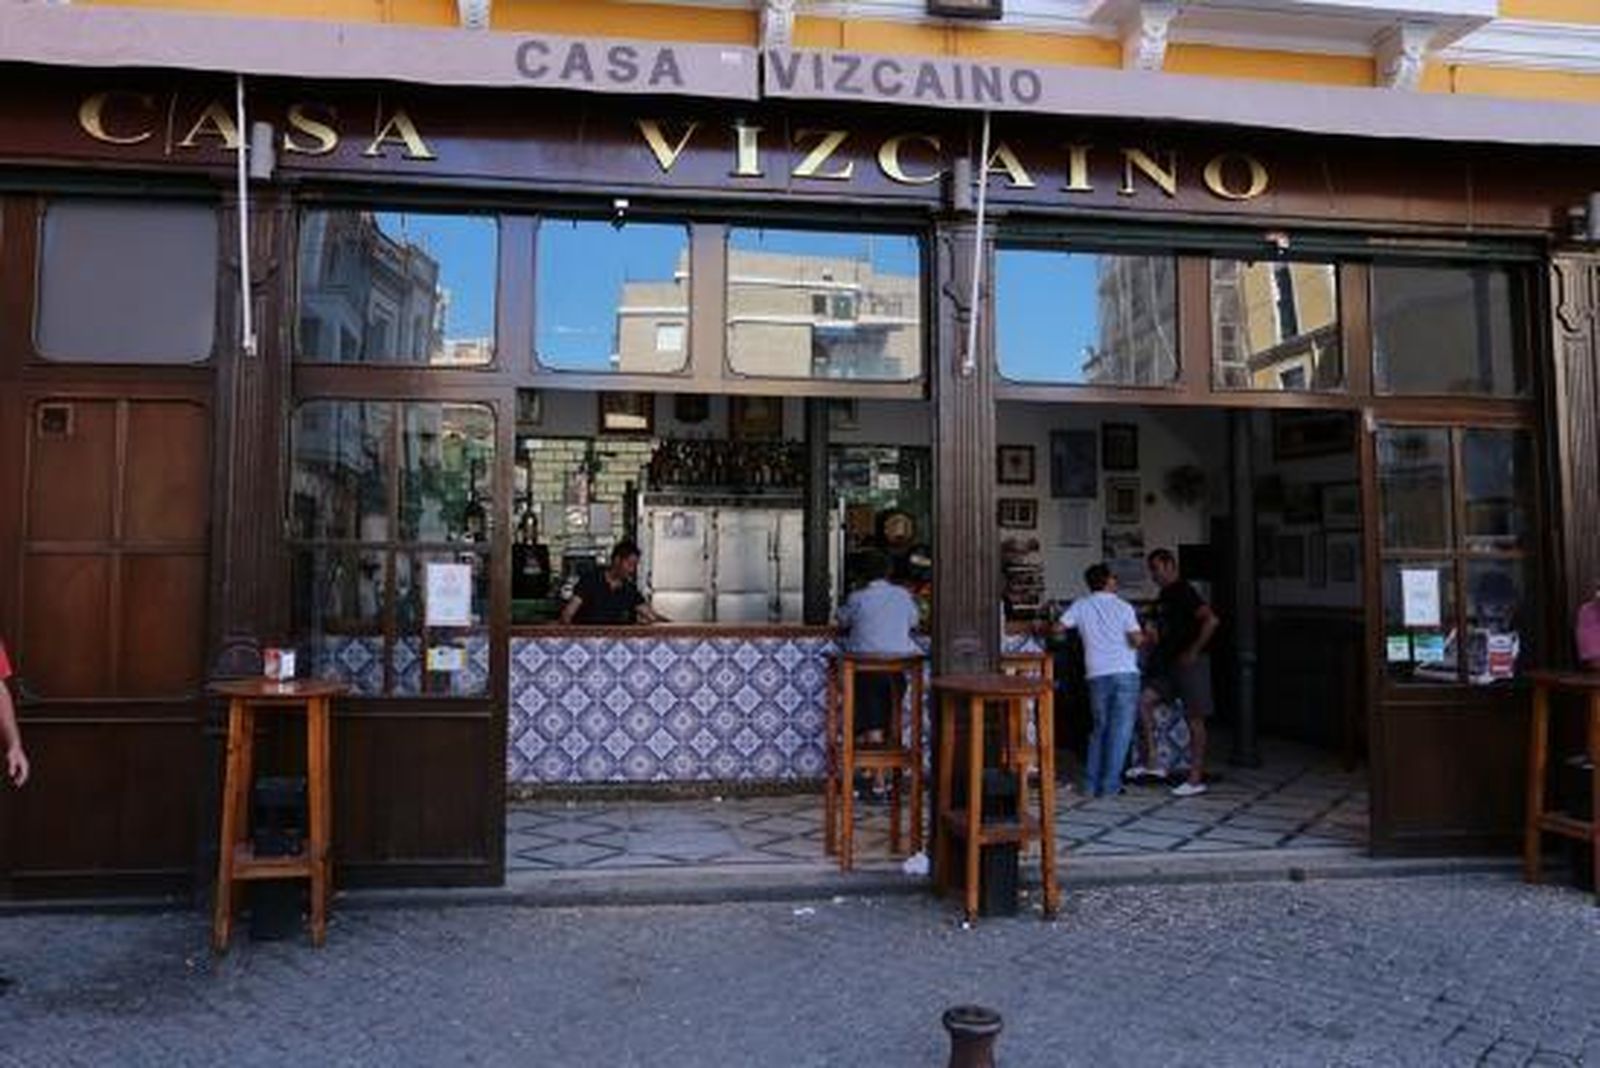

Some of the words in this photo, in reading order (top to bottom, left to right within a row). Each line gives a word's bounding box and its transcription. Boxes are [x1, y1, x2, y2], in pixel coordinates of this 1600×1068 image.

[514, 38, 685, 86] CASA
[767, 51, 1043, 104] VIZCAINO
[78, 91, 438, 160] CASA
[638, 118, 1270, 200] VIZCAINO
